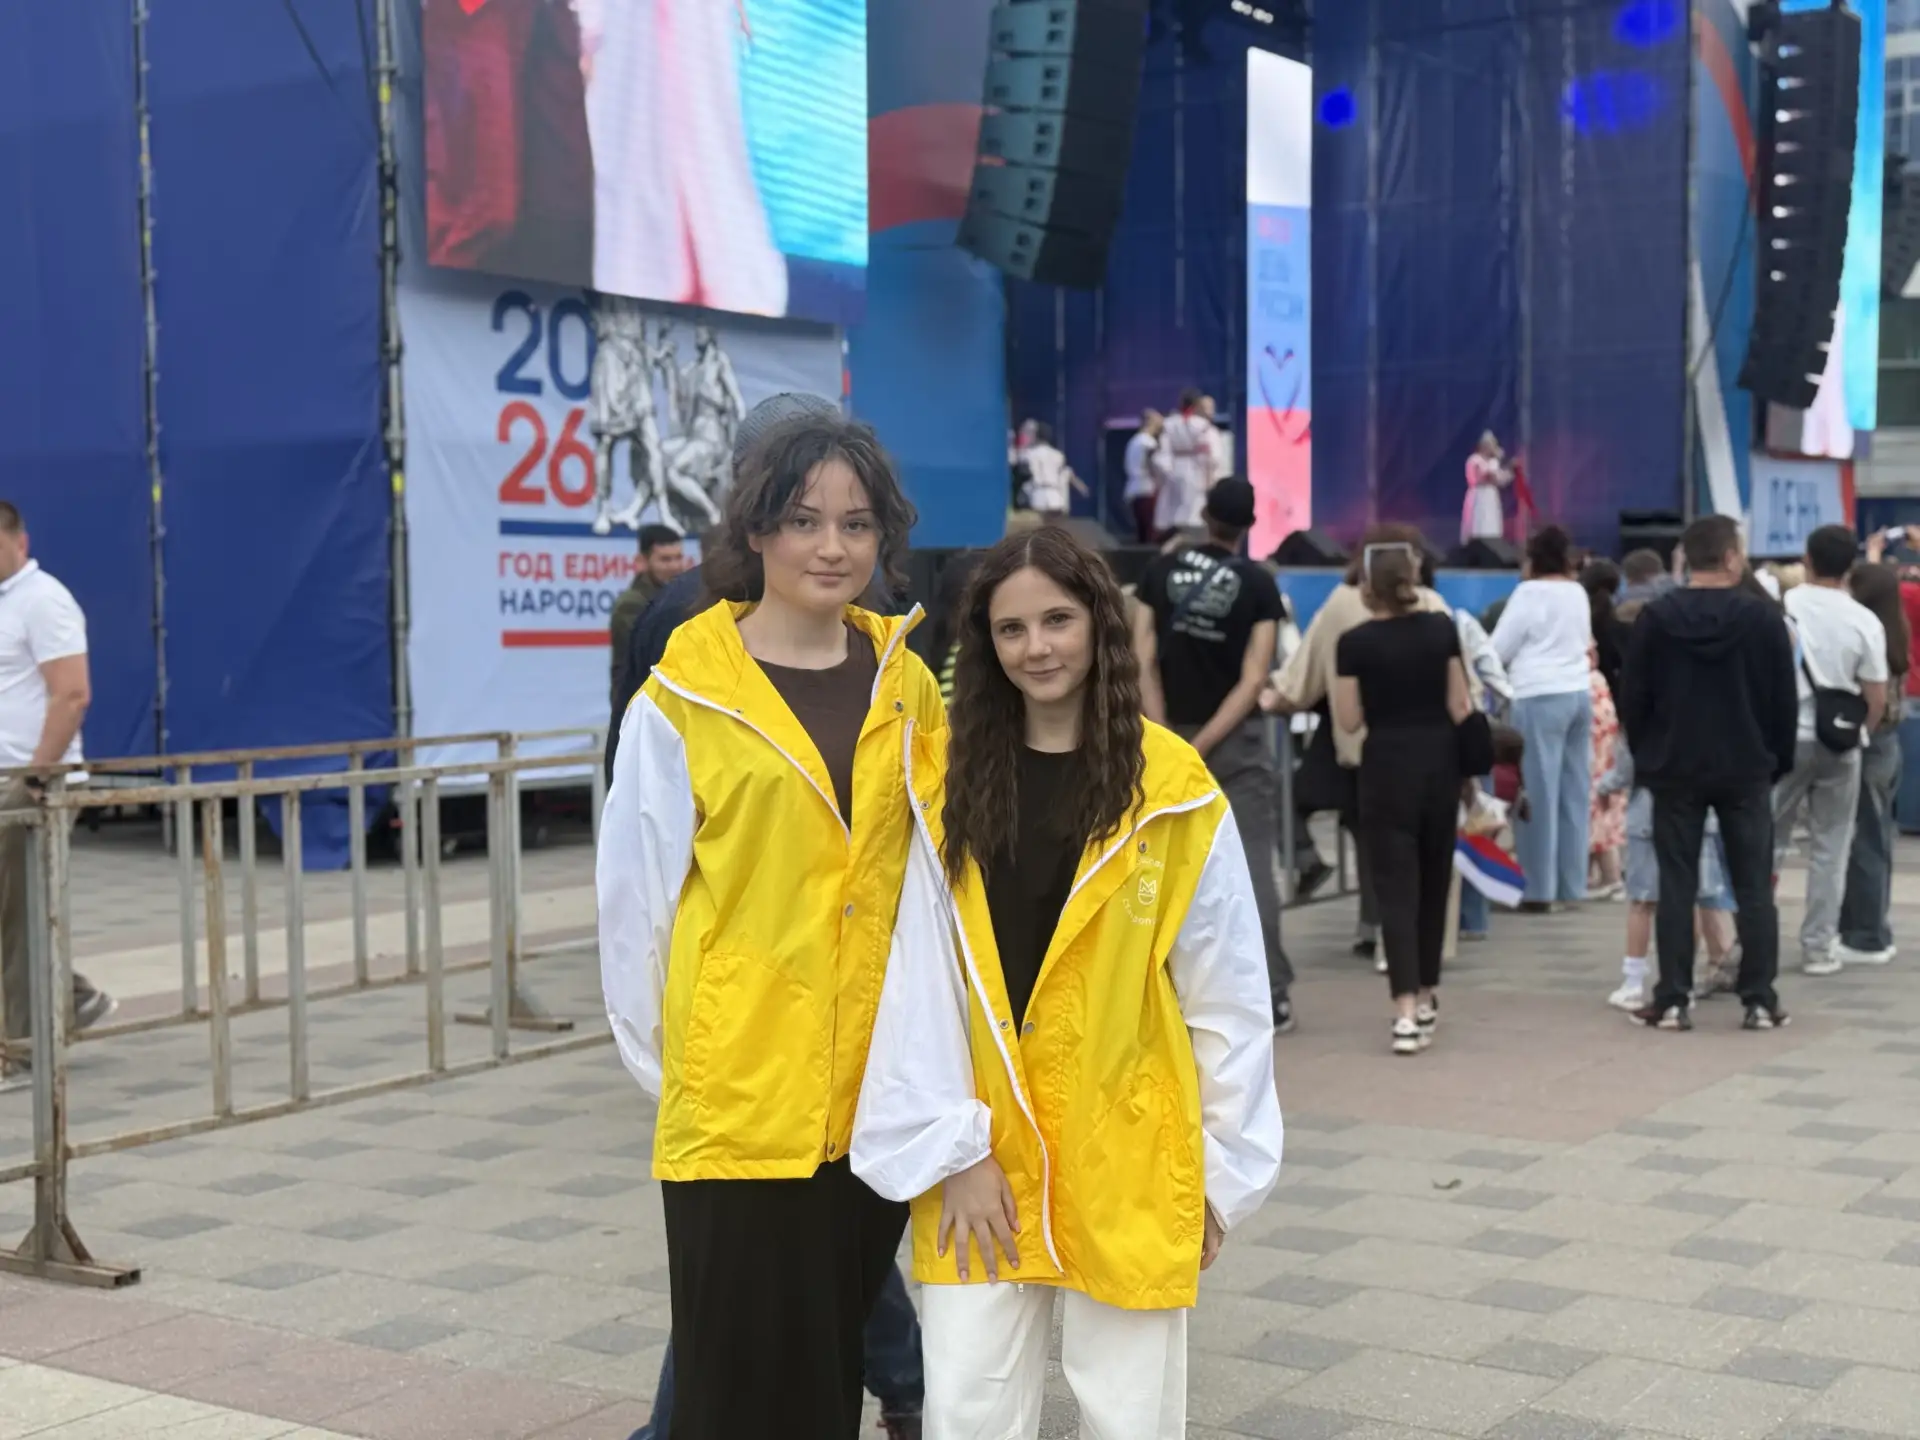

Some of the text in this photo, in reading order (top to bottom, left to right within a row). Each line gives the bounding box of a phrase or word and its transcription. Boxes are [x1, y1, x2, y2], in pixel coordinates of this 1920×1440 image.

[491, 289, 597, 402] 20
[496, 399, 597, 509] 26
[499, 552, 554, 581] ГОД
[500, 588, 622, 618] НАРОДО
